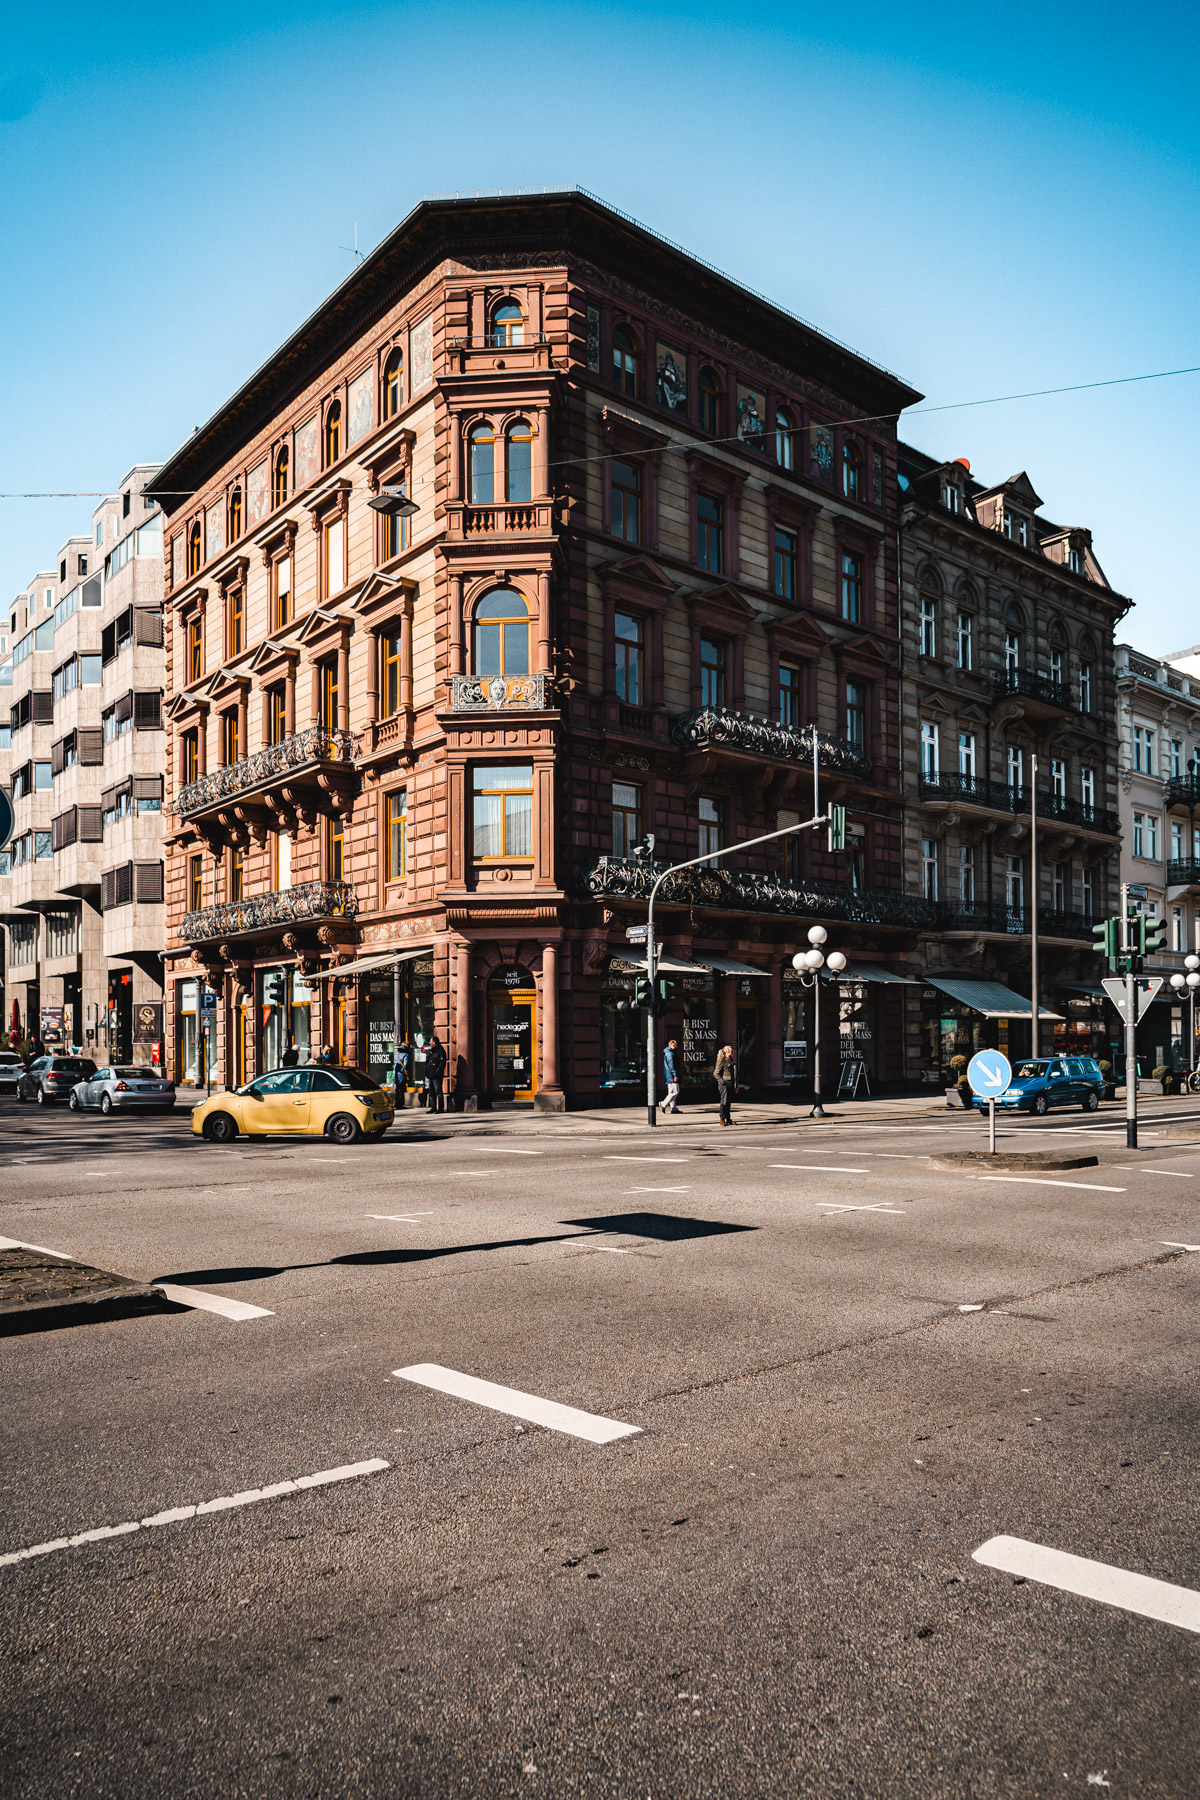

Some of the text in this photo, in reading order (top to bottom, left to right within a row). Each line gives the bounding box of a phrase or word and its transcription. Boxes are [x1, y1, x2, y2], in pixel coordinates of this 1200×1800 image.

[506, 970, 518, 978] seit
[504, 978, 521, 986] 1976
[204, 995, 213, 1007] P
[369, 1020, 394, 1031] DU BIST
[496, 1023, 529, 1032] hedegger
[691, 1018, 711, 1029] BIST
[369, 1032, 395, 1042] DAS MAS
[694, 1030, 718, 1040] MASS
[854, 1030, 872, 1040] MASS
[369, 1043, 383, 1053] DER
[683, 1041, 695, 1051] ER
[840, 1040, 855, 1049] DER
[683, 1051, 707, 1062] INGE.
[786, 1047, 805, 1056] -50%
[840, 1050, 864, 1059] DINGE.
[369, 1054, 391, 1064] DINGE.
